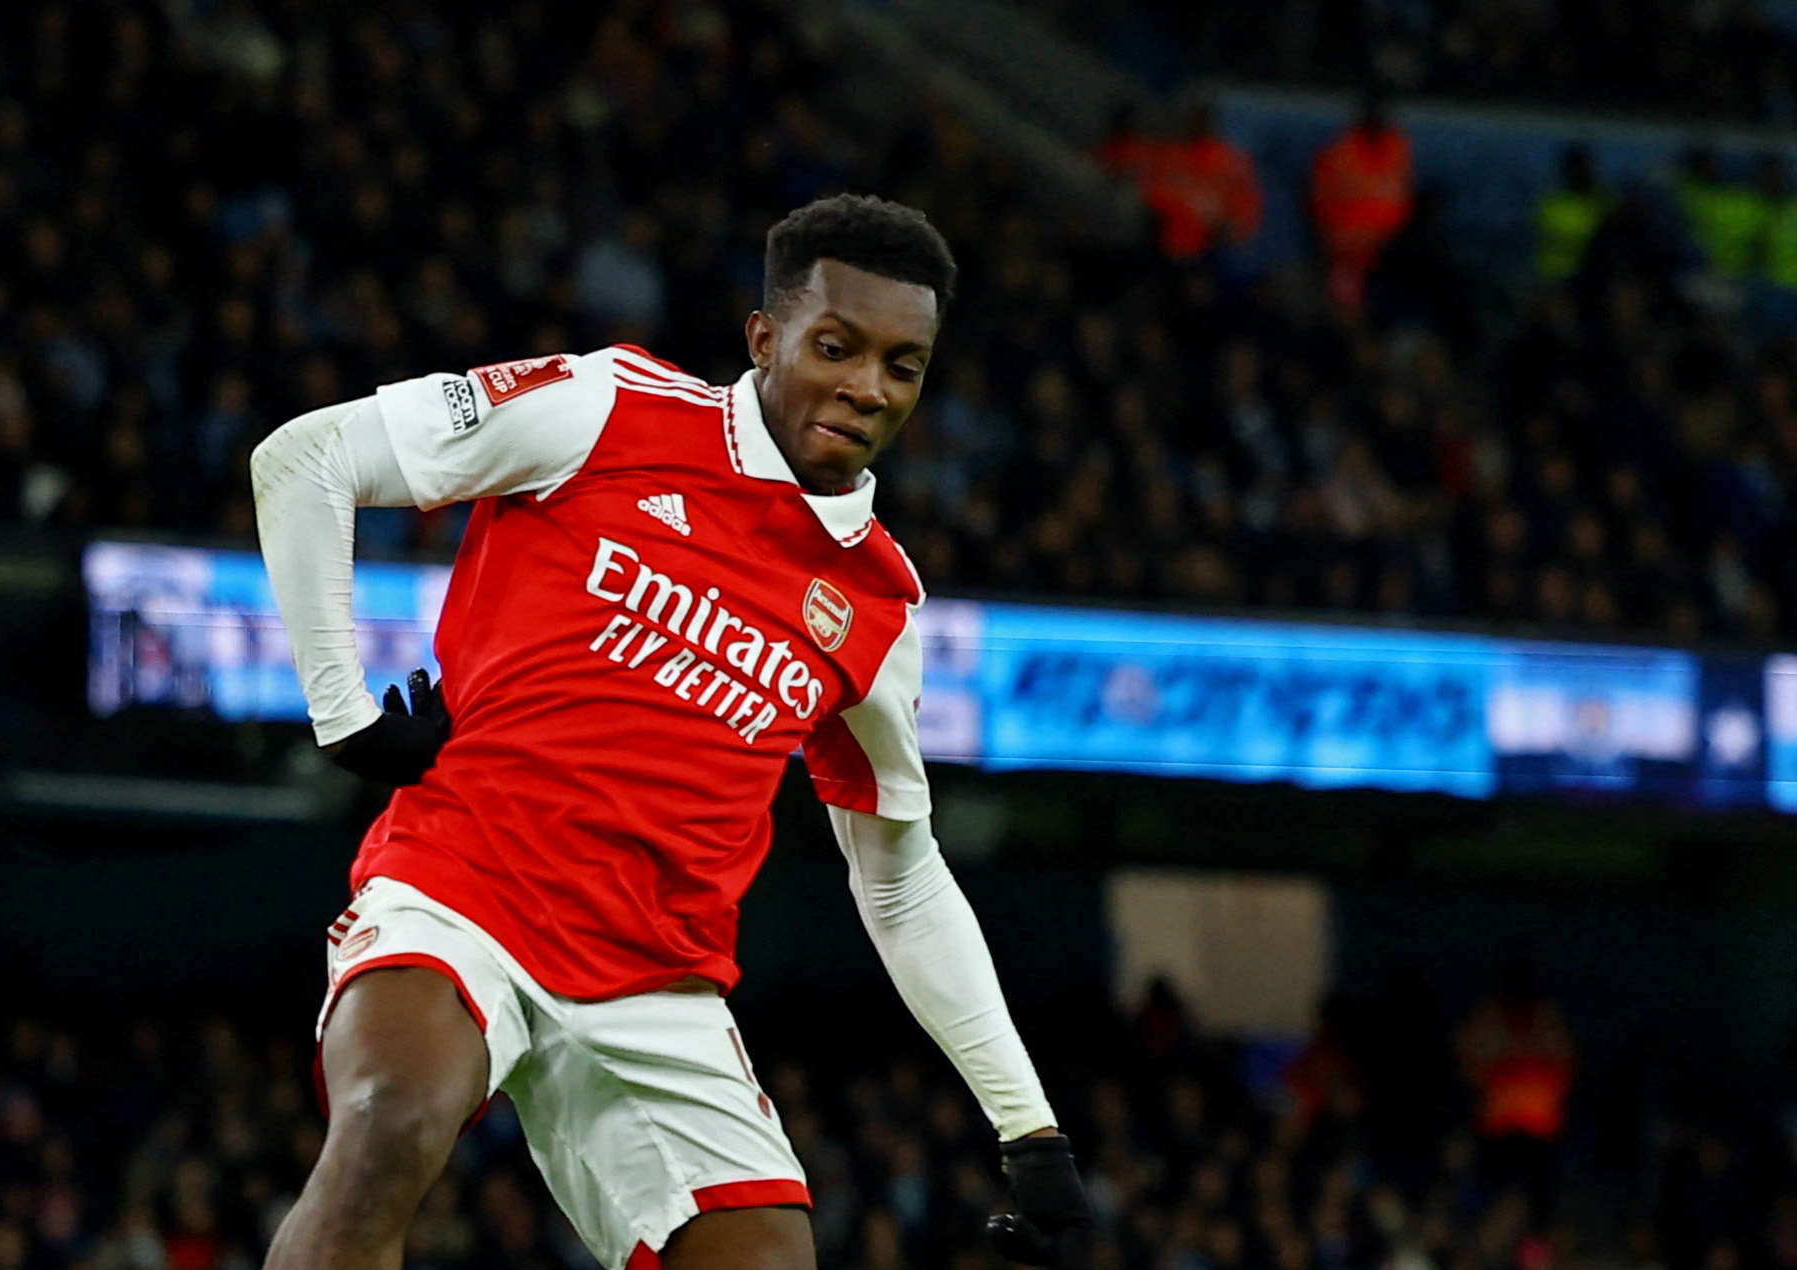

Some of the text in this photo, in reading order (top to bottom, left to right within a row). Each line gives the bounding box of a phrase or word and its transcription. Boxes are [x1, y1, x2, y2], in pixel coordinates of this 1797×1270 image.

[454, 379, 476, 422] room
[637, 499, 691, 536] adidas
[586, 537, 823, 720] Emirates
[589, 614, 778, 745] FLY BETTER
